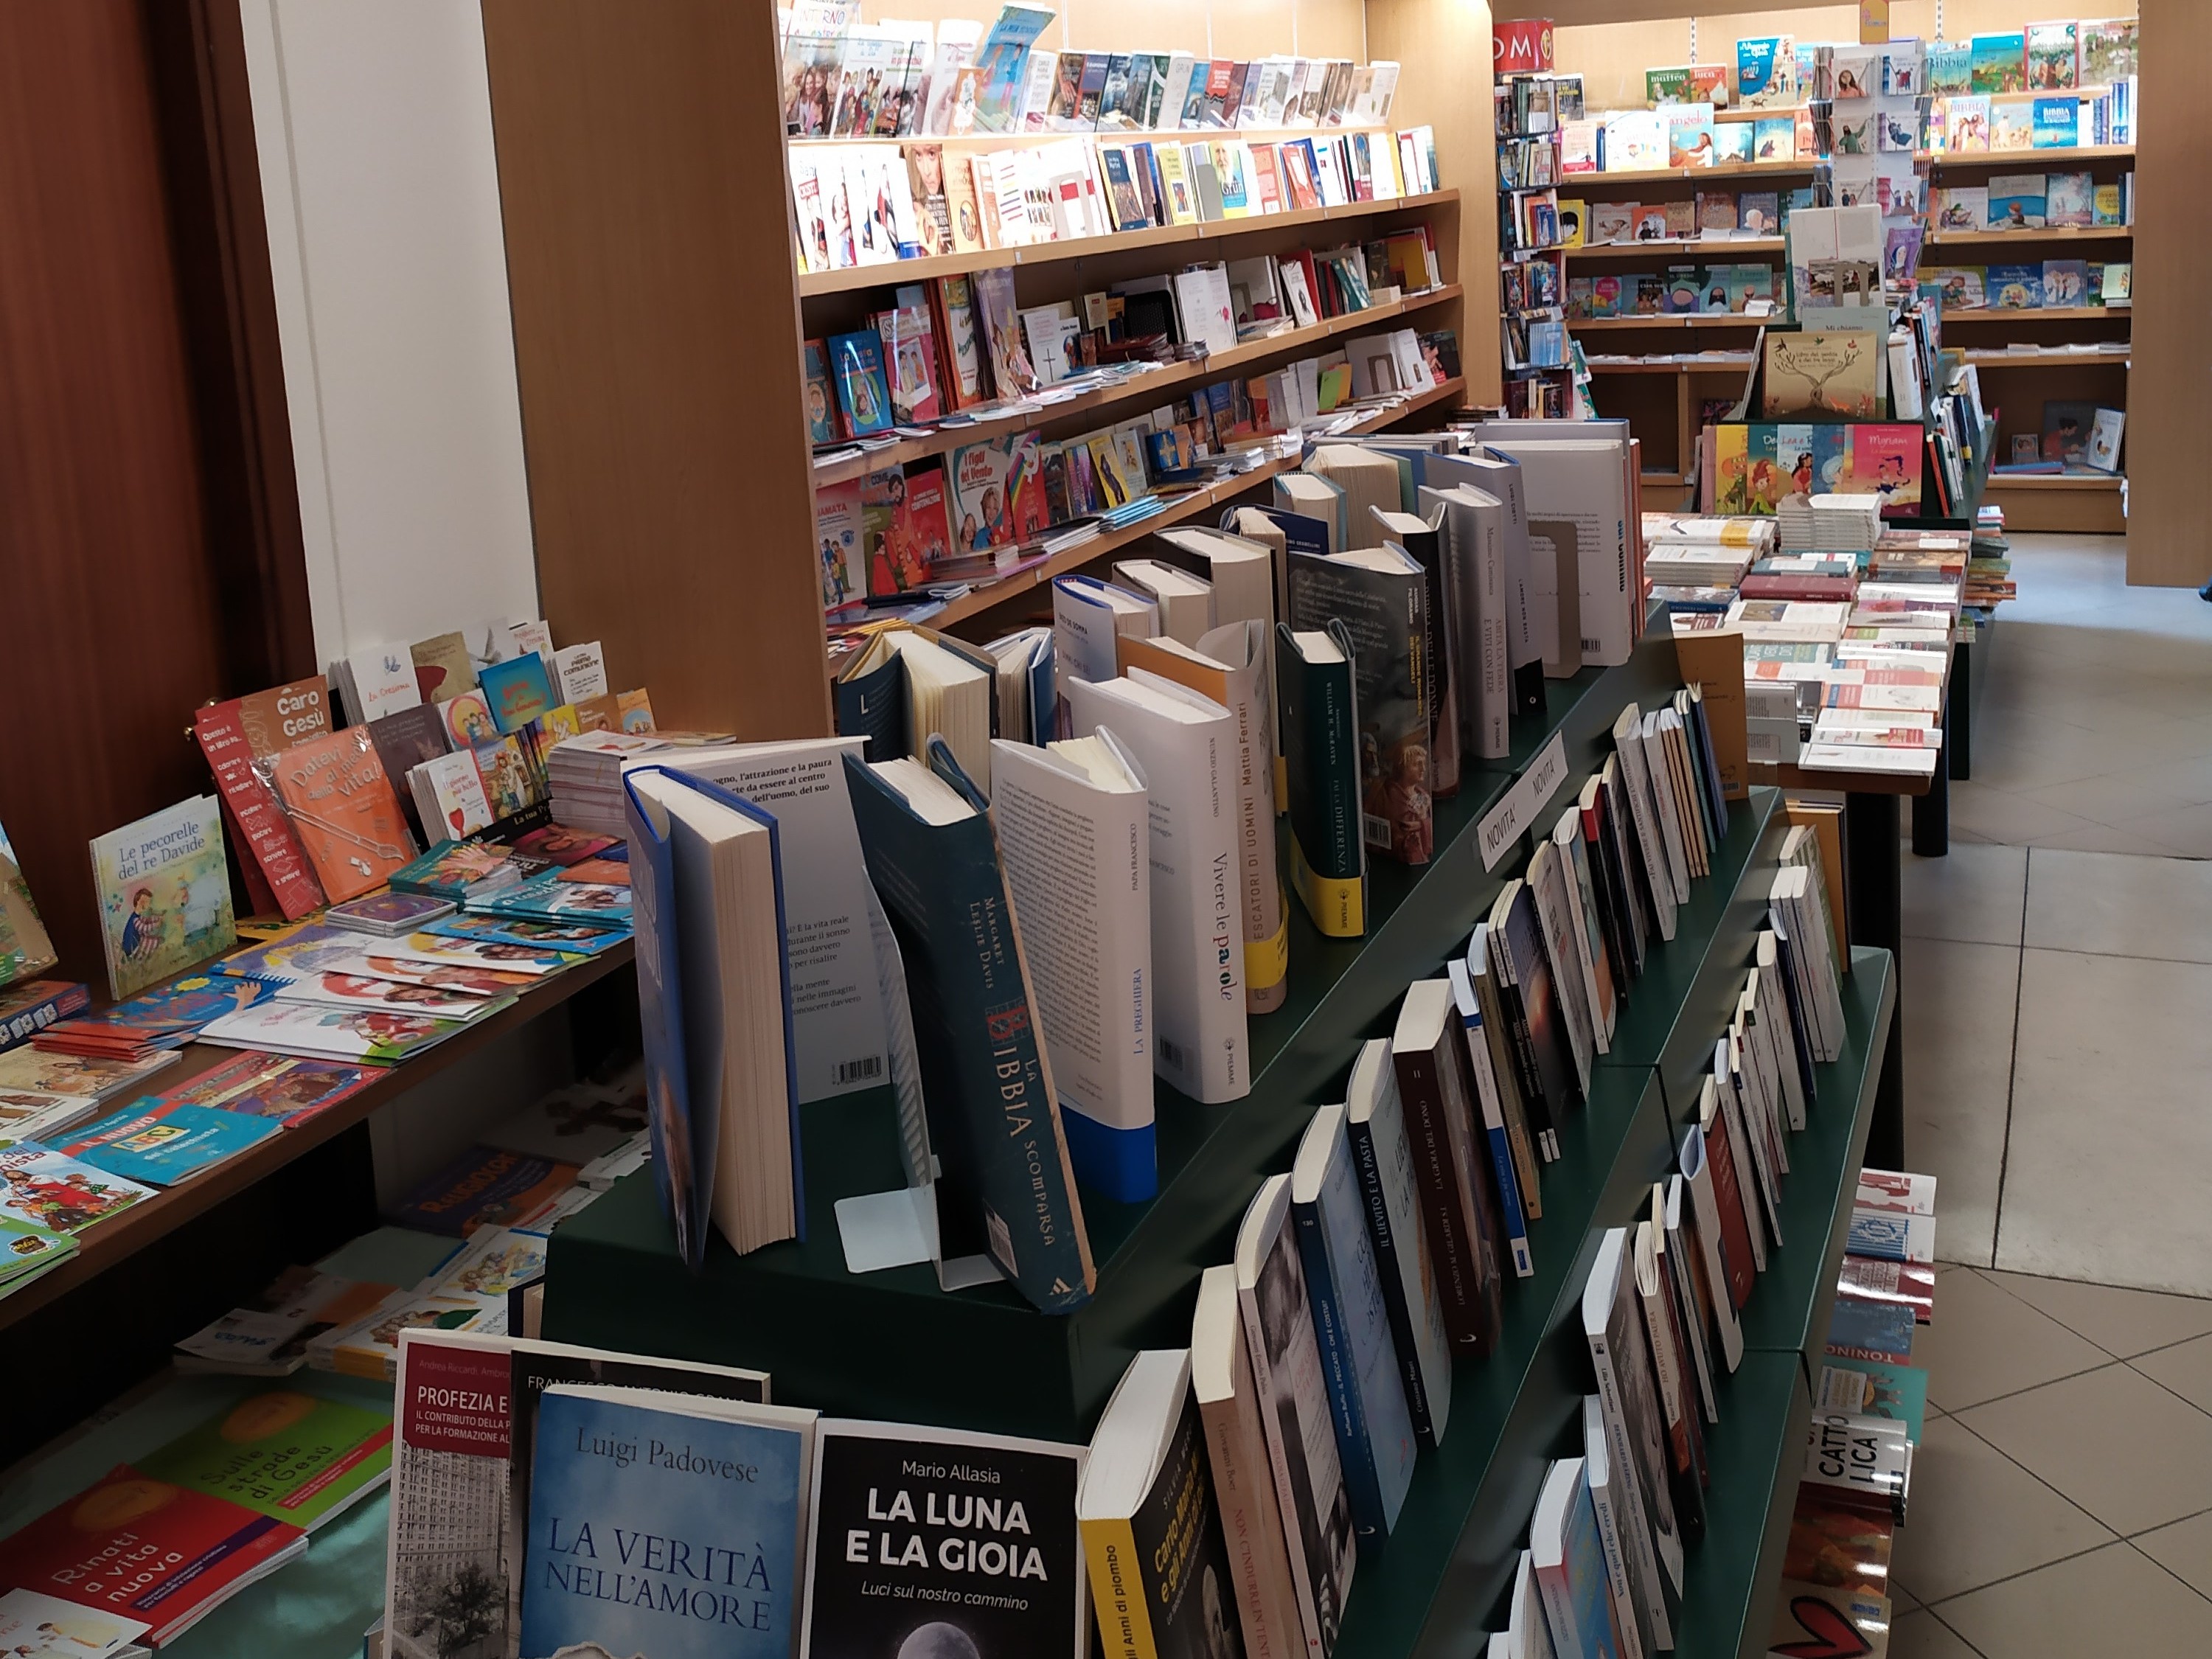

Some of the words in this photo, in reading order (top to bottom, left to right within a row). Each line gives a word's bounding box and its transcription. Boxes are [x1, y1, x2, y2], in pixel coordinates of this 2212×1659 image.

[1950, 102, 1986, 111] BIBBIA
[1669, 116, 1708, 128] angelo
[1485, 526, 1496, 557] Massimo
[1403, 587, 1418, 624] FILORAMO
[1411, 587, 1422, 613] AUGIAS
[1483, 627, 1493, 647] VIVI
[1492, 618, 1503, 645] ABITA
[1407, 651, 1419, 684] VANGELI
[1484, 649, 1494, 668] CON
[1495, 647, 1503, 659] LA
[1484, 671, 1495, 695] FEDE
[1495, 662, 1505, 692] TERRA
[276, 690, 319, 715] Caro
[1326, 681, 1334, 714] WILLIAM
[1413, 677, 1427, 717] ROMANZO
[1428, 674, 1439, 722] DONNE
[282, 708, 324, 737] Gesù
[1237, 702, 1248, 743] Ferrari
[291, 745, 343, 788] Datevi
[326, 770, 339, 784] al
[338, 762, 381, 797] vita!
[740, 768, 790, 782] l'attrazione
[799, 763, 807, 771] la
[808, 759, 832, 771] paura
[1242, 746, 1253, 787] Mattia
[1531, 754, 1556, 799] NOVITA'
[747, 783, 757, 793] da
[759, 779, 787, 790] essere
[788, 776, 797, 785] al
[799, 772, 826, 783] centro
[751, 791, 799, 804] dell'uomo,
[800, 785, 813, 795] del
[815, 784, 830, 793] suo
[1210, 770, 1219, 817] GALANTINO
[514, 815, 525, 826] La
[525, 810, 538, 821] tua
[1243, 796, 1256, 847] UOMINI
[1486, 802, 1517, 853] NOVITA'
[120, 848, 136, 863] Le
[140, 821, 200, 855] pecorelle
[1334, 806, 1346, 873] DIFFERENZA
[118, 860, 139, 880] del
[142, 855, 158, 871] re
[161, 837, 206, 863] Davide
[1248, 853, 1258, 866] DI
[1212, 852, 1229, 910] Vivere
[1248, 873, 1263, 939] ESCATORI
[804, 923, 813, 931] la
[815, 920, 829, 929] vita
[830, 916, 849, 925] reale
[826, 928, 851, 939] sonno
[984, 897, 1005, 967] MARGARET
[1216, 915, 1231, 930] le
[810, 941, 841, 953] davvero
[970, 901, 987, 948] LESLIE
[980, 950, 995, 991] DAVIS
[794, 961, 808, 970] per
[810, 953, 838, 965] risalire
[1213, 935, 1237, 1001] parole
[797, 992, 817, 1003] nelle
[818, 985, 857, 999] immagini
[805, 978, 831, 990] mente
[830, 995, 862, 1008] davvero
[1131, 968, 1144, 1032] PREGHIERA
[1133, 1037, 1143, 1054] LA
[1024, 1057, 1037, 1082] LA
[1226, 1053, 1234, 1085] PIEMME
[1418, 1099, 1431, 1127] DONO
[102, 1116, 158, 1141] NUOVO
[1425, 1130, 1435, 1147] DEL
[3, 1146, 30, 1161] del
[1358, 1135, 1373, 1168] PASTA
[1427, 1149, 1441, 1176] GIOIA
[1366, 1171, 1376, 1184] LA
[1433, 1177, 1444, 1190] LA
[1024, 1139, 1056, 1248] SCOMPARSA
[1371, 1195, 1387, 1235] LIEVITO
[1380, 1237, 1389, 1247] IL
[1441, 1217, 1455, 1253] GILARDI
[1450, 1265, 1466, 1306] LORENZO
[1649, 1311, 1660, 1338] PAURA
[419, 1360, 446, 1371] Andrea
[1331, 1351, 1343, 1382] PECCATO
[1654, 1340, 1666, 1368] AVUTO
[1825, 1345, 1895, 1364] TONINO
[1600, 1367, 1609, 1381] Lilia
[1660, 1369, 1669, 1383] HO
[417, 1385, 494, 1413] PROFEZIA
[498, 1395, 508, 1413] E
[1411, 1382, 1424, 1412] Cristiano
[1604, 1382, 1616, 1413] Sebastiani
[415, 1423, 430, 1434] PER
[431, 1425, 442, 1436] LA
[443, 1427, 498, 1443] FORMAZIONE
[416, 1409, 423, 1419] IL
[424, 1411, 476, 1427] CONTRIBUTO
[478, 1417, 504, 1429] DELLA
[1342, 1411, 1353, 1436] Raffaele
[577, 1427, 639, 1468] Luigi
[647, 1439, 760, 1484] Padovese
[1217, 1422, 1234, 1470] Giovanni
[1613, 1422, 1627, 1461] BERNHARD
[1818, 1414, 1849, 1478] CATTO
[201, 1449, 264, 1485] Sulle
[227, 1445, 301, 1493] strade
[250, 1485, 274, 1500] di
[271, 1444, 333, 1482] Gesù
[902, 1460, 946, 1480] Mario
[949, 1464, 1001, 1484] Allasia
[1849, 1436, 1878, 1484] LICA
[867, 1487, 917, 1523] LA
[926, 1492, 1032, 1535] LUNA
[1232, 1509, 1248, 1537] NON
[1598, 1501, 1610, 1528] credi
[1155, 1518, 1179, 1573] Carlo
[1604, 1528, 1615, 1547] che
[51, 1532, 139, 1585] Rinati
[85, 1580, 103, 1594] a
[105, 1543, 160, 1579] vita
[549, 1517, 597, 1559] LA
[613, 1527, 773, 1593] VERITÀ
[846, 1529, 870, 1564] E
[880, 1531, 930, 1568] LA
[938, 1537, 1048, 1582] GIOIA
[1105, 1543, 1125, 1597] piombo
[1608, 1548, 1621, 1571] quel
[106, 1550, 184, 1603] nuova
[544, 1561, 773, 1633] NELL'AMORE
[861, 1580, 891, 1596] Luci
[893, 1584, 916, 1599] sul
[917, 1586, 961, 1603] nostro
[964, 1591, 1029, 1612] cammino
[1114, 1599, 1127, 1613] di
[1161, 1582, 1170, 1604] e
[1118, 1615, 1135, 1646] Anni
